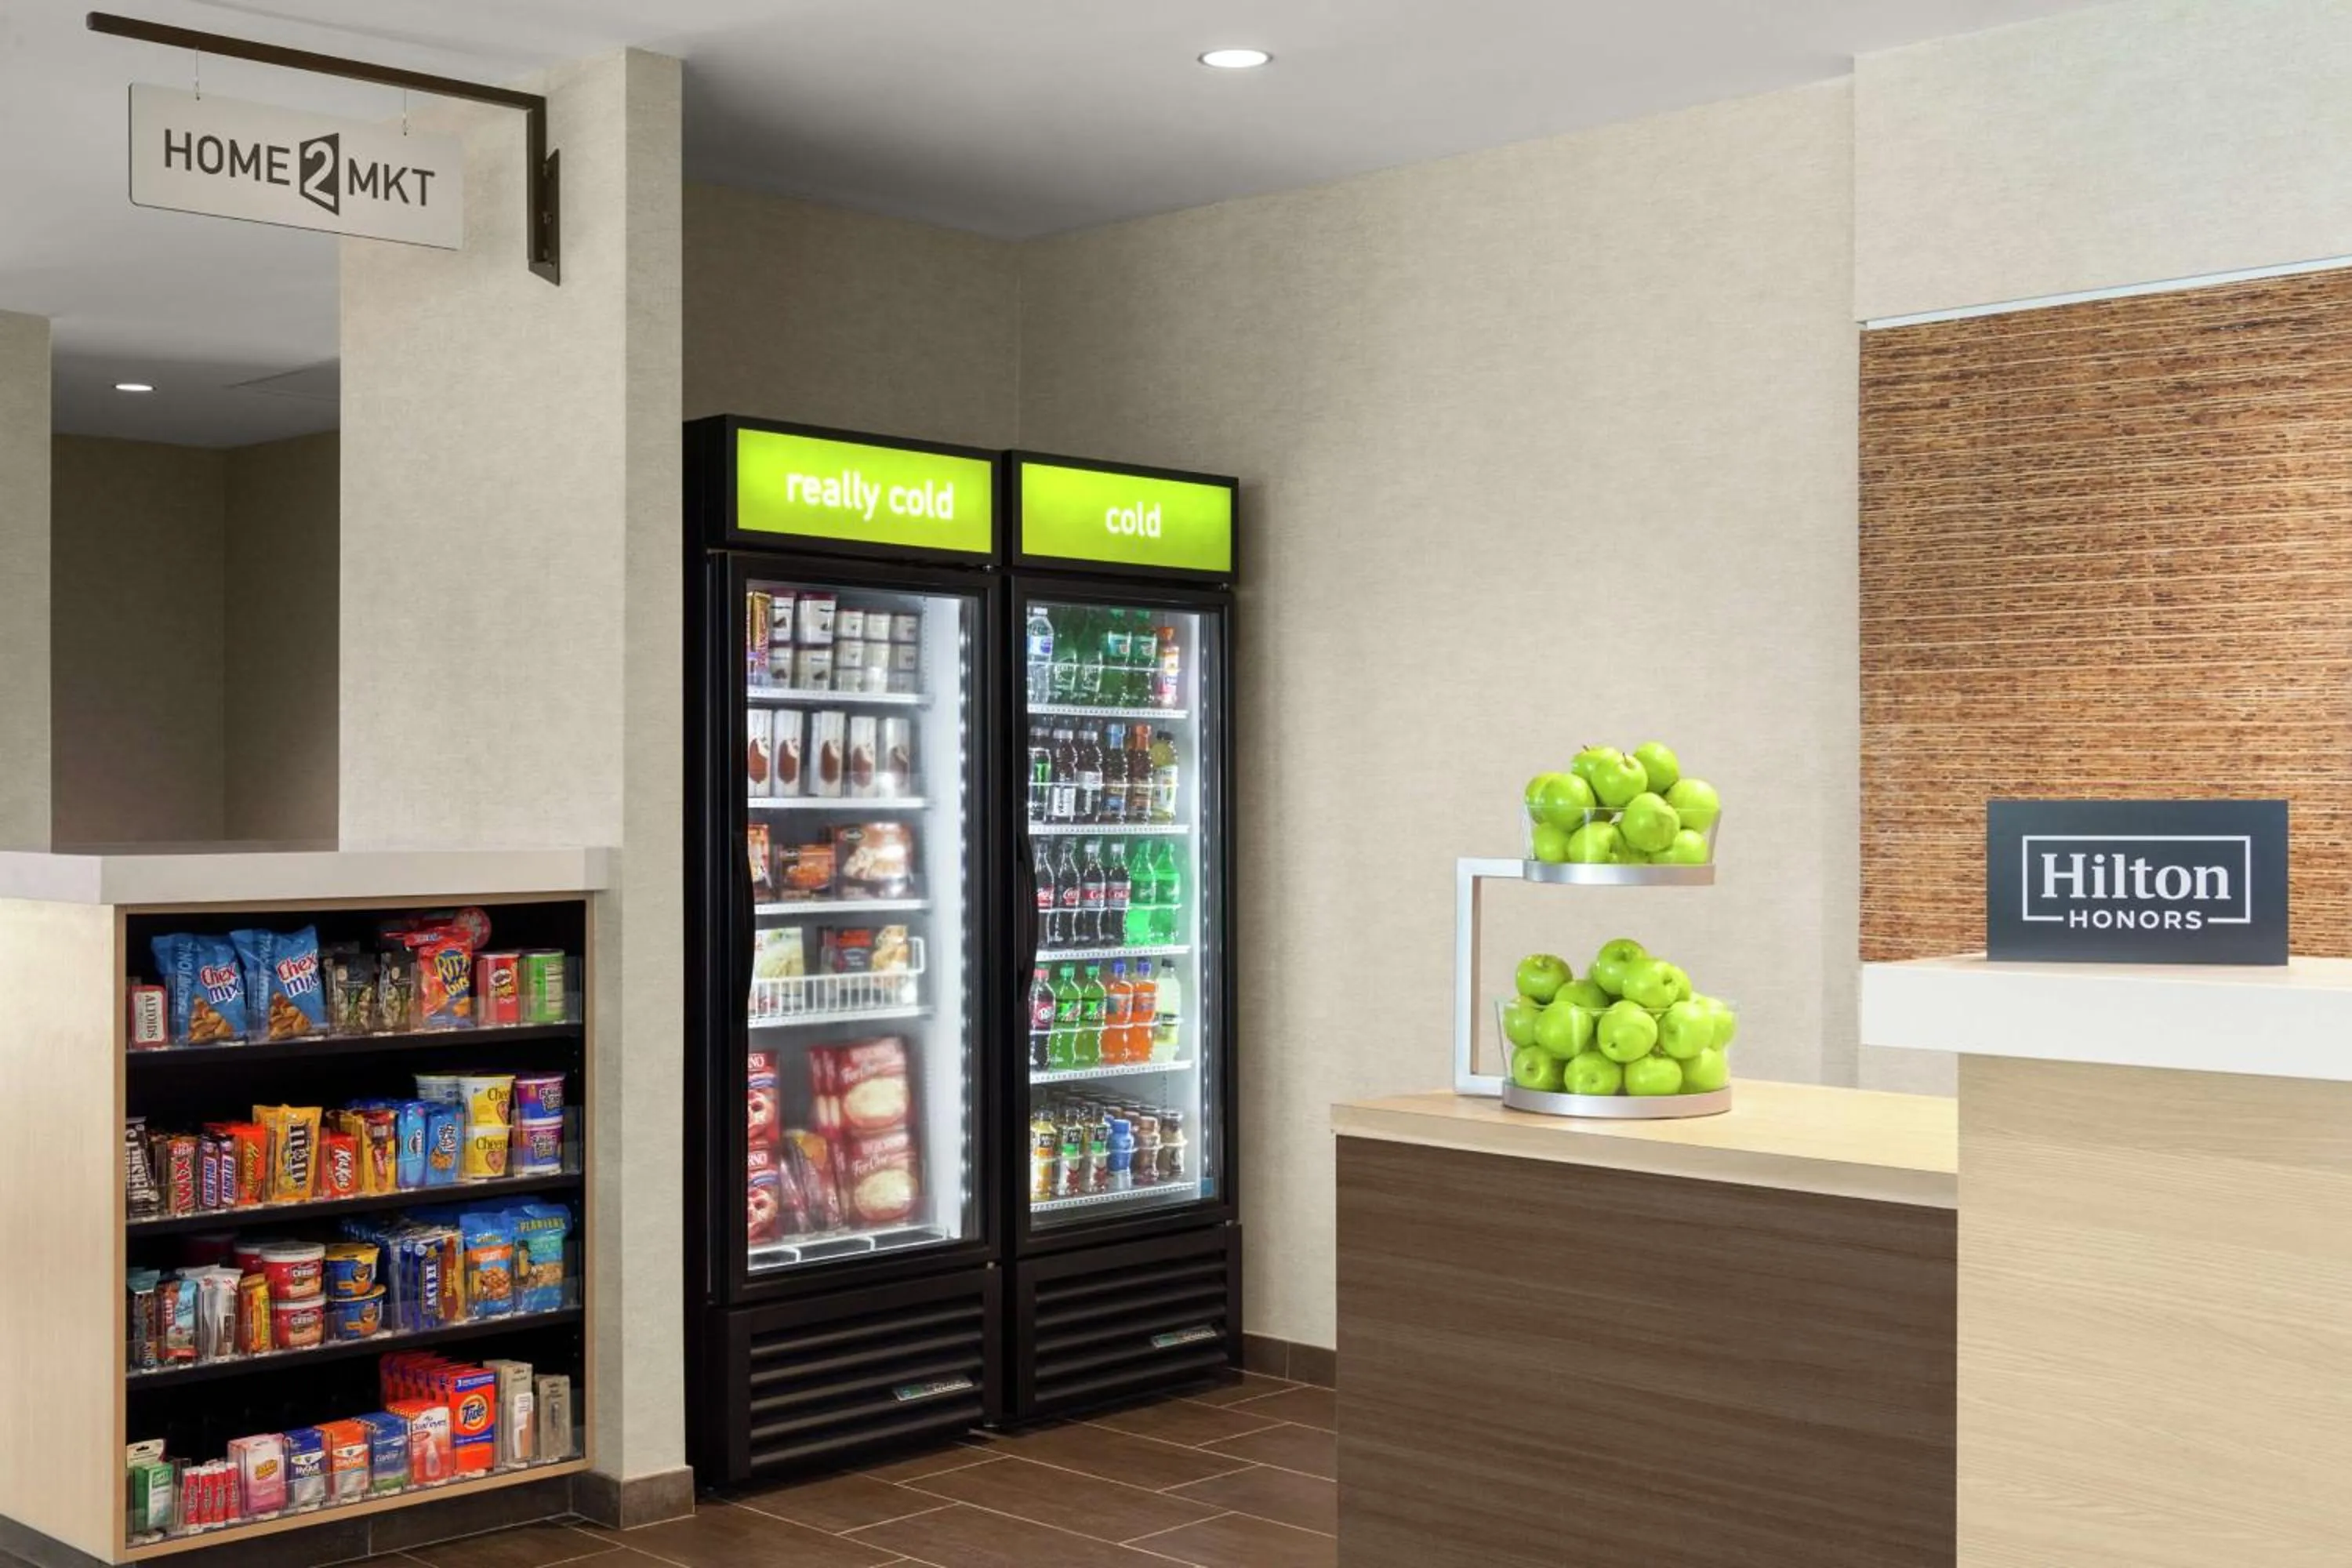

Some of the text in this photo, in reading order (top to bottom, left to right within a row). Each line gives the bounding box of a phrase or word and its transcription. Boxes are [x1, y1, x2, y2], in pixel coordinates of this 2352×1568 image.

[786, 470, 954, 520] really cold
[1105, 502, 1162, 538] cold
[2041, 853, 2231, 900] Hilton
[2069, 909, 2202, 930] HONORS
[201, 962, 235, 985] Chex
[276, 949, 318, 980] Chex
[145, 995, 158, 1039] ALTOIDS
[462, 1403, 486, 1425] Tide
